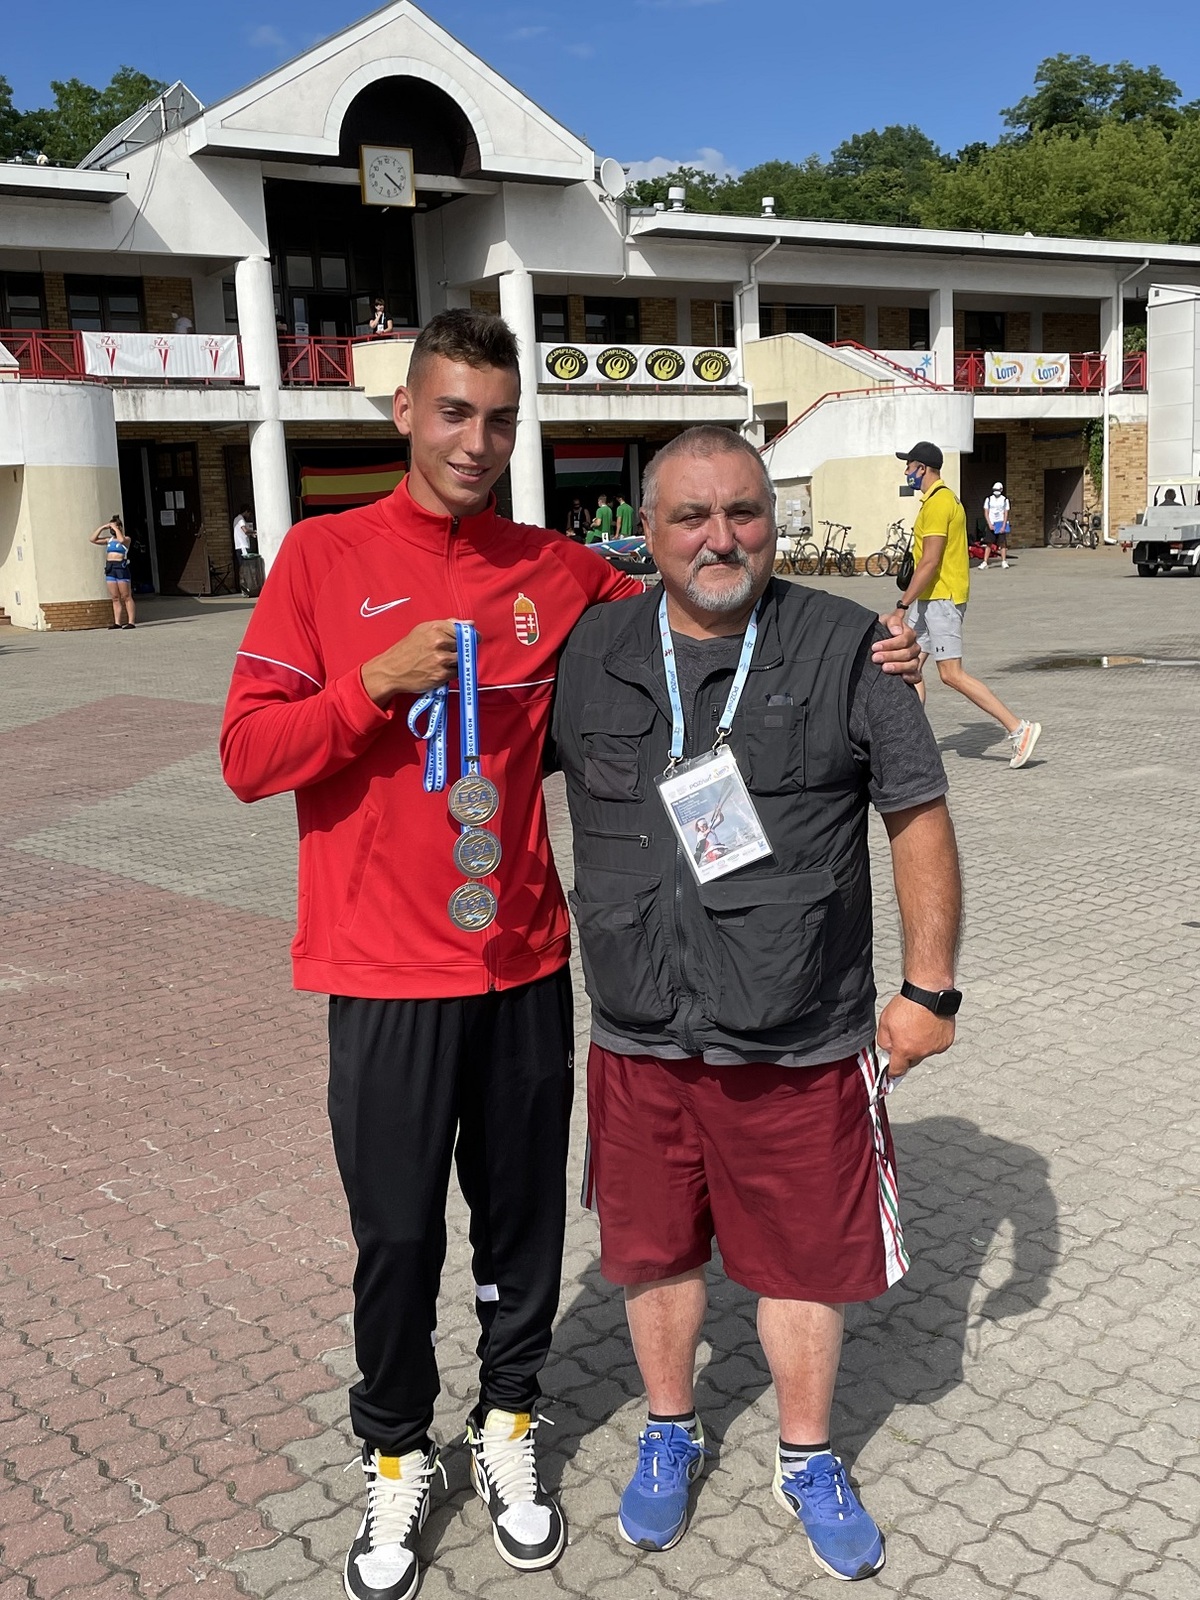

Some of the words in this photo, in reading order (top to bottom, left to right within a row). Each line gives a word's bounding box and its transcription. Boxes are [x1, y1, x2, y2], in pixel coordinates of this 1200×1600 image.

[101, 336, 116, 346] PZK
[154, 336, 169, 347] PZK
[205, 338, 219, 348] PZK
[996, 365, 1018, 380] LOTTO
[1038, 365, 1059, 380] LOTTO
[458, 791, 489, 804] ECA
[462, 843, 492, 857] ECA
[458, 896, 487, 910] ECA
